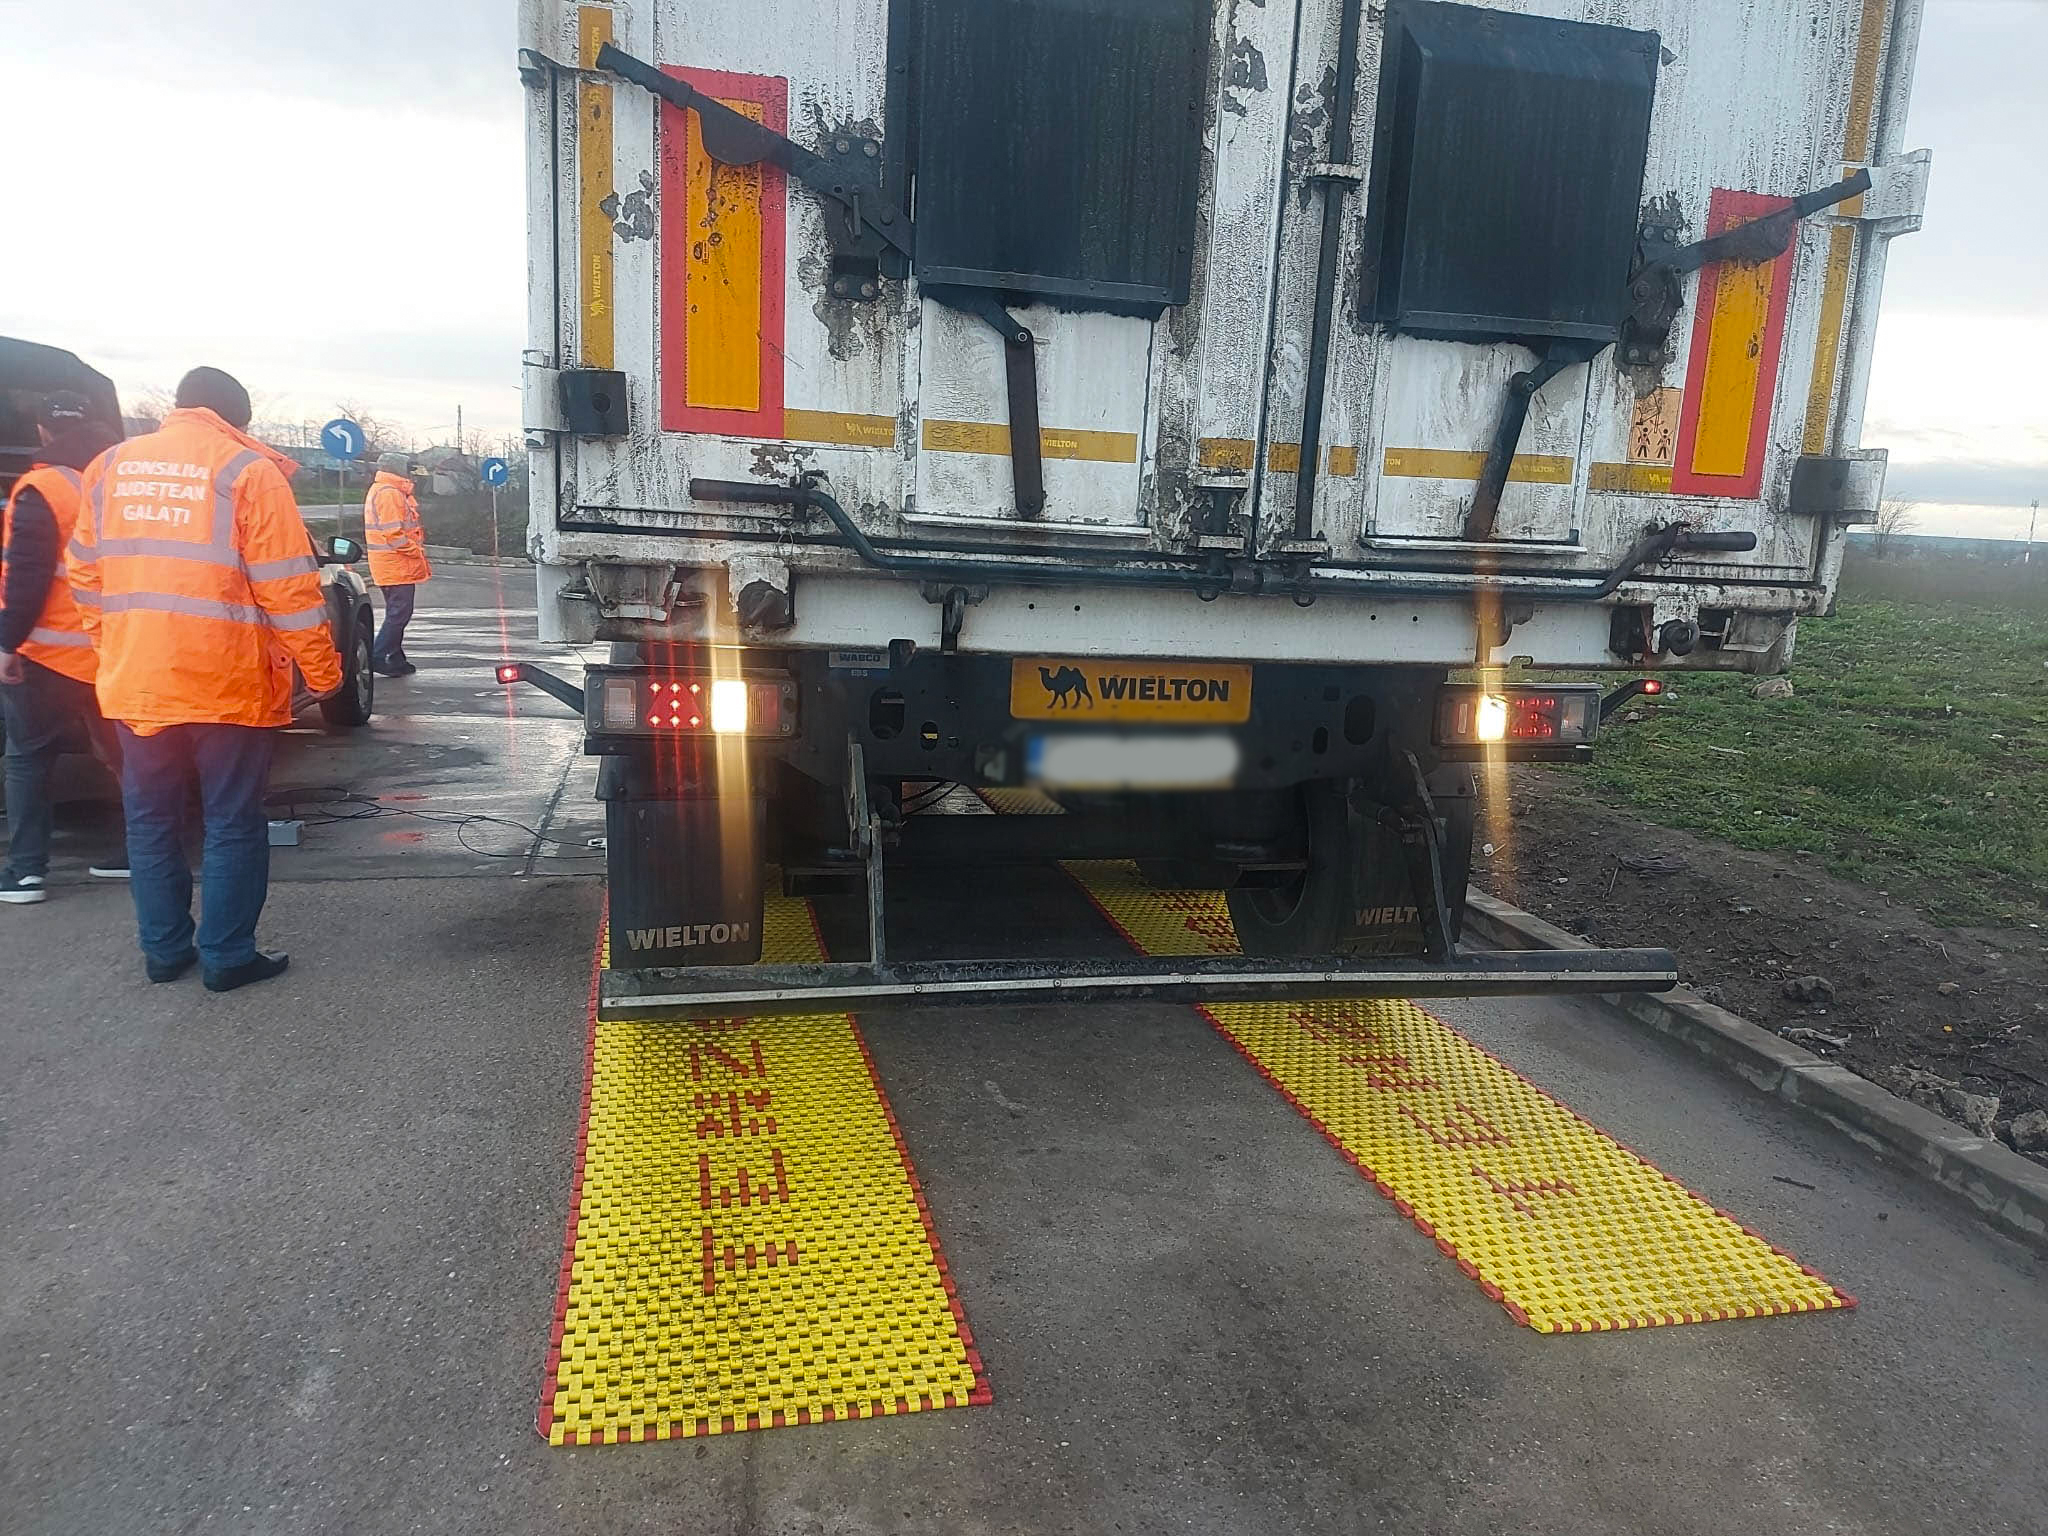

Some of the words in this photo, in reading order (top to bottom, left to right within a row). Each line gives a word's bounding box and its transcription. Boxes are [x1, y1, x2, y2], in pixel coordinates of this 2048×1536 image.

[592, 254, 601, 298] WIELTON
[862, 425, 895, 436] WIELTO
[839, 653, 881, 663] WABCO
[1098, 676, 1230, 702] WIELTON
[1355, 906, 1421, 926] WIELT
[625, 922, 750, 951] WIELTON
